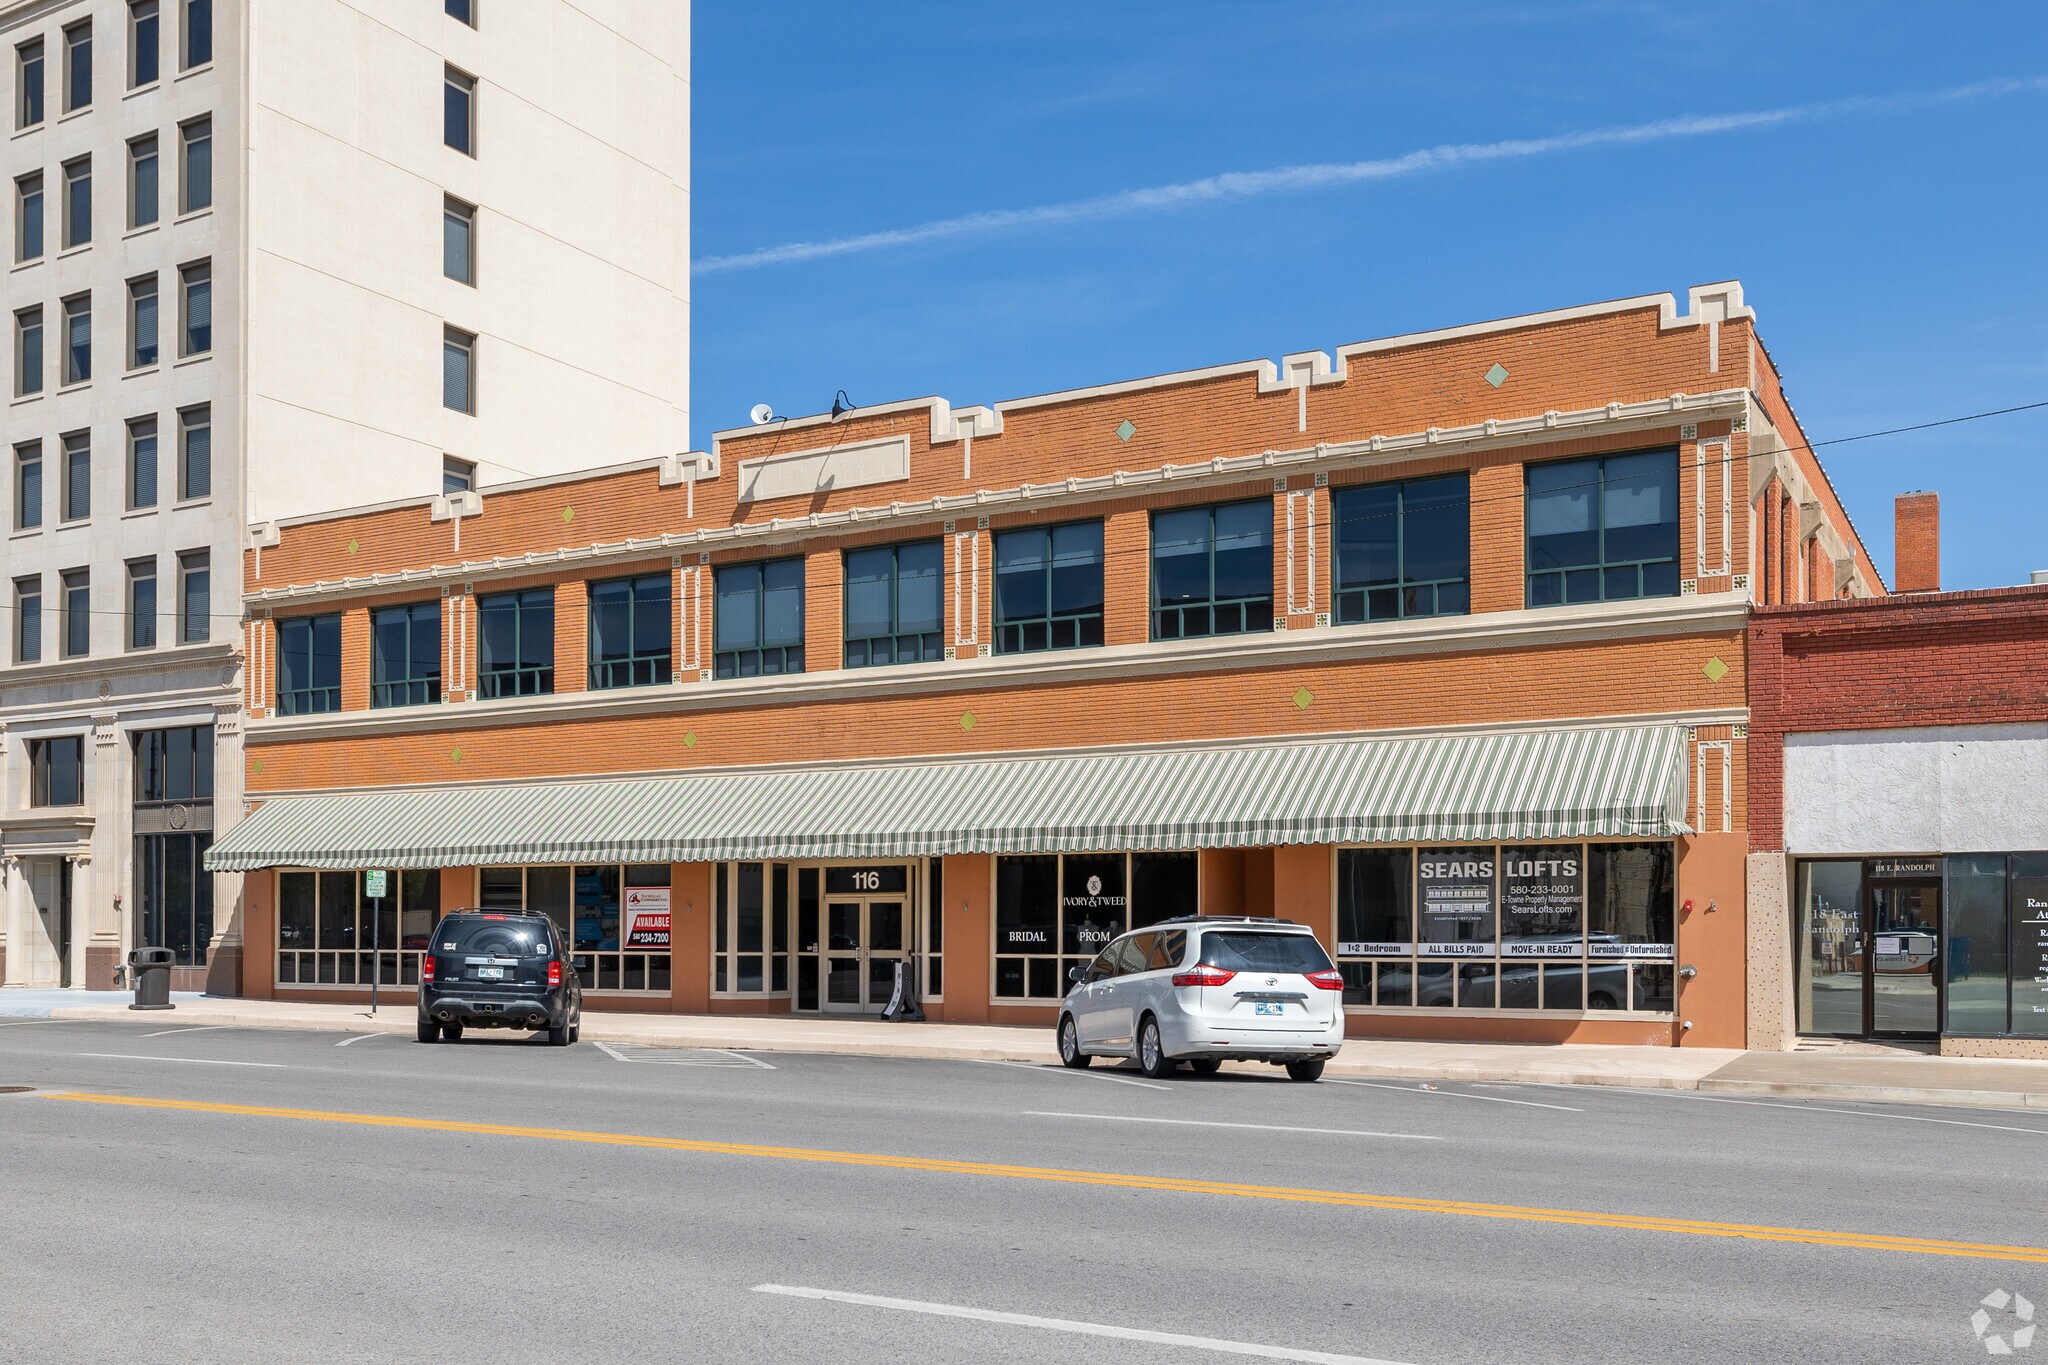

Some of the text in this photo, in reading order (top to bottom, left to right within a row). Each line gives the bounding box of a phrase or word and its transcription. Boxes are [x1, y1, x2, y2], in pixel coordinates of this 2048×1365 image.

[1420, 860, 1577, 878] SEARS LOFTS
[1895, 864, 1936, 872] RANDOLPH
[368, 872, 374, 880] 2
[852, 871, 880, 890] 116
[1510, 885, 1574, 894] 580-233-0001
[1502, 895, 1583, 905] E-Towne Property Management
[1512, 905, 1572, 914] SearsLofts.com
[1832, 908, 1858, 919] East
[636, 917, 670, 927] AVAILABLE
[1804, 922, 1860, 935] Randolph
[640, 933, 669, 942] 234-7200
[1009, 932, 1046, 942] BRIDAL
[1079, 931, 1110, 942] PROM
[1364, 944, 1401, 952] Bedroom
[1428, 945, 1484, 954] ALL BILLS PAID
[1511, 945, 1573, 954] MOVE-IN READY
[1591, 945, 1624, 954] Furnished
[1630, 945, 1672, 954] Unfurnished
